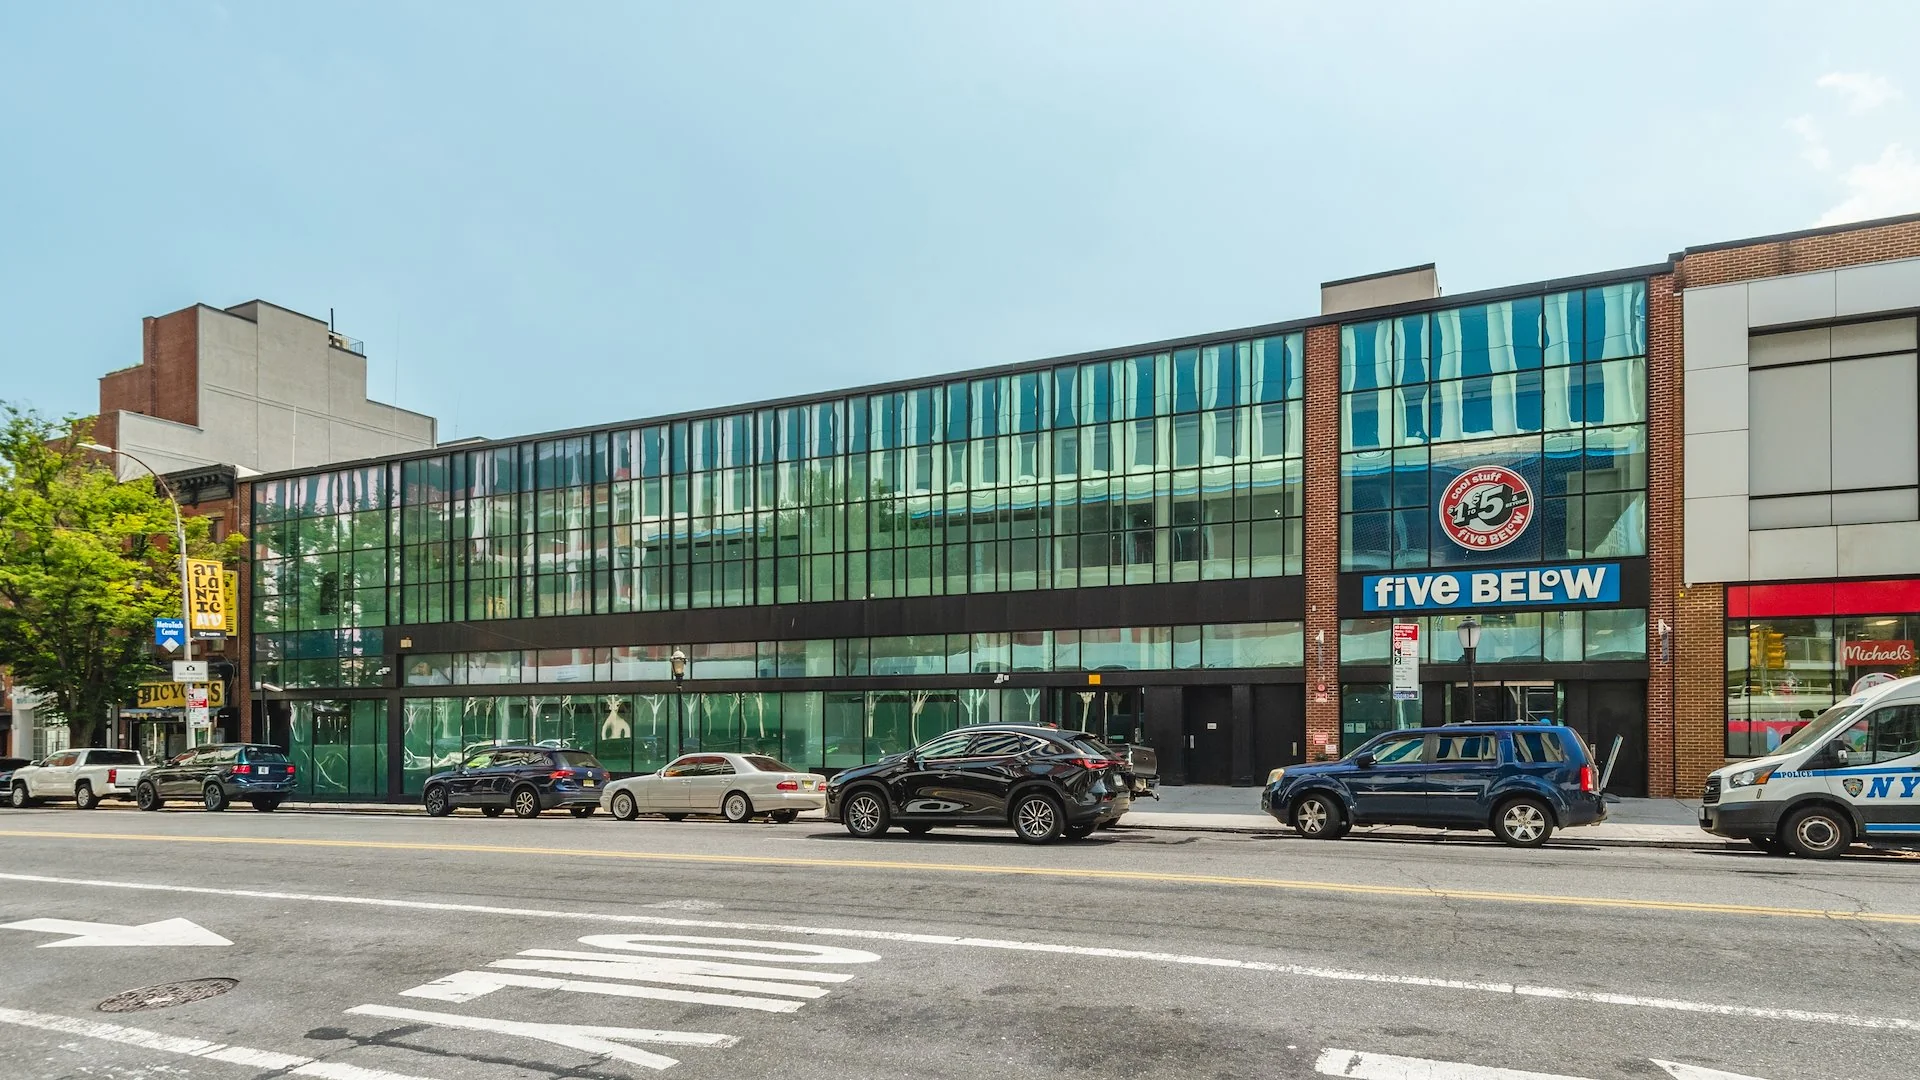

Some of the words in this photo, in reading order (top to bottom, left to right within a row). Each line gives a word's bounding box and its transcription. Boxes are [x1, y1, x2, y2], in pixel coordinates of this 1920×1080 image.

[1451, 478, 1471, 499] cool
[1472, 472, 1502, 483] stuff
[1505, 498, 1527, 508] BEYOND
[1467, 508, 1476, 516] TO
[1457, 529, 1487, 545] five
[1375, 574, 1460, 607] five
[156, 620, 184, 629] MetroTech
[161, 628, 179, 636] Center
[1842, 644, 1912, 661] Michaels
[137, 683, 221, 704] BICYCS
